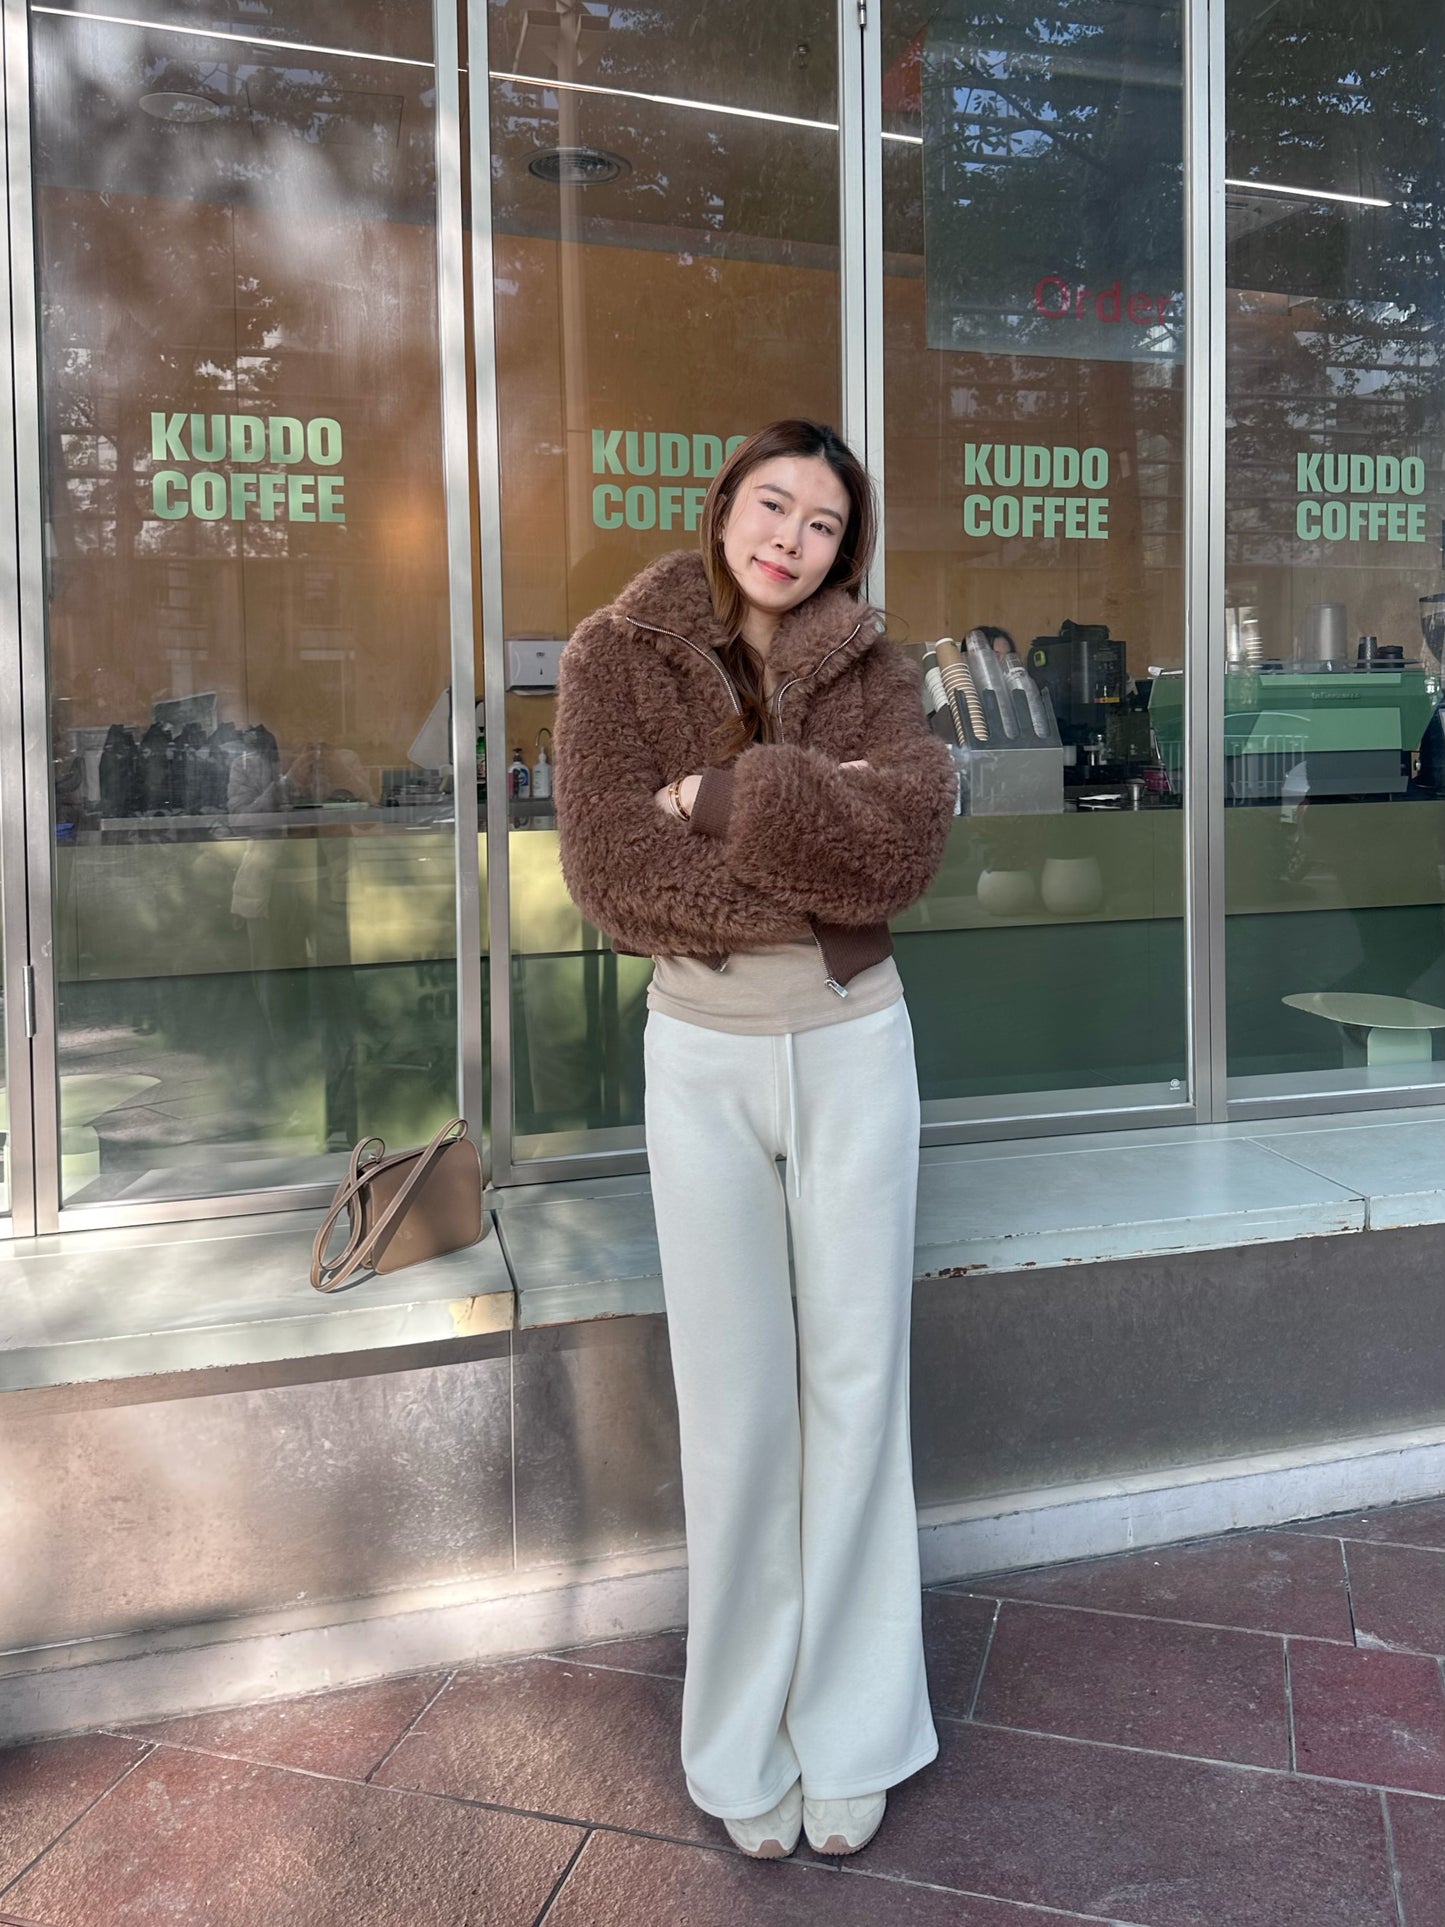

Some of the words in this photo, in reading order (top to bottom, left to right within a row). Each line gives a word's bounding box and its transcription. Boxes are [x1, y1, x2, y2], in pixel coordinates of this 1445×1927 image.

[1034, 276, 1174, 326] Order
[150, 411, 343, 466] KUDDO
[591, 428, 748, 478] KUDD
[963, 442, 1110, 489] KUDDO
[1296, 452, 1426, 496] KUDDO
[152, 470, 346, 523] COFFEE
[592, 483, 708, 531] COFF
[963, 494, 1110, 540] COFFEE
[1296, 500, 1427, 542] COFFEE
